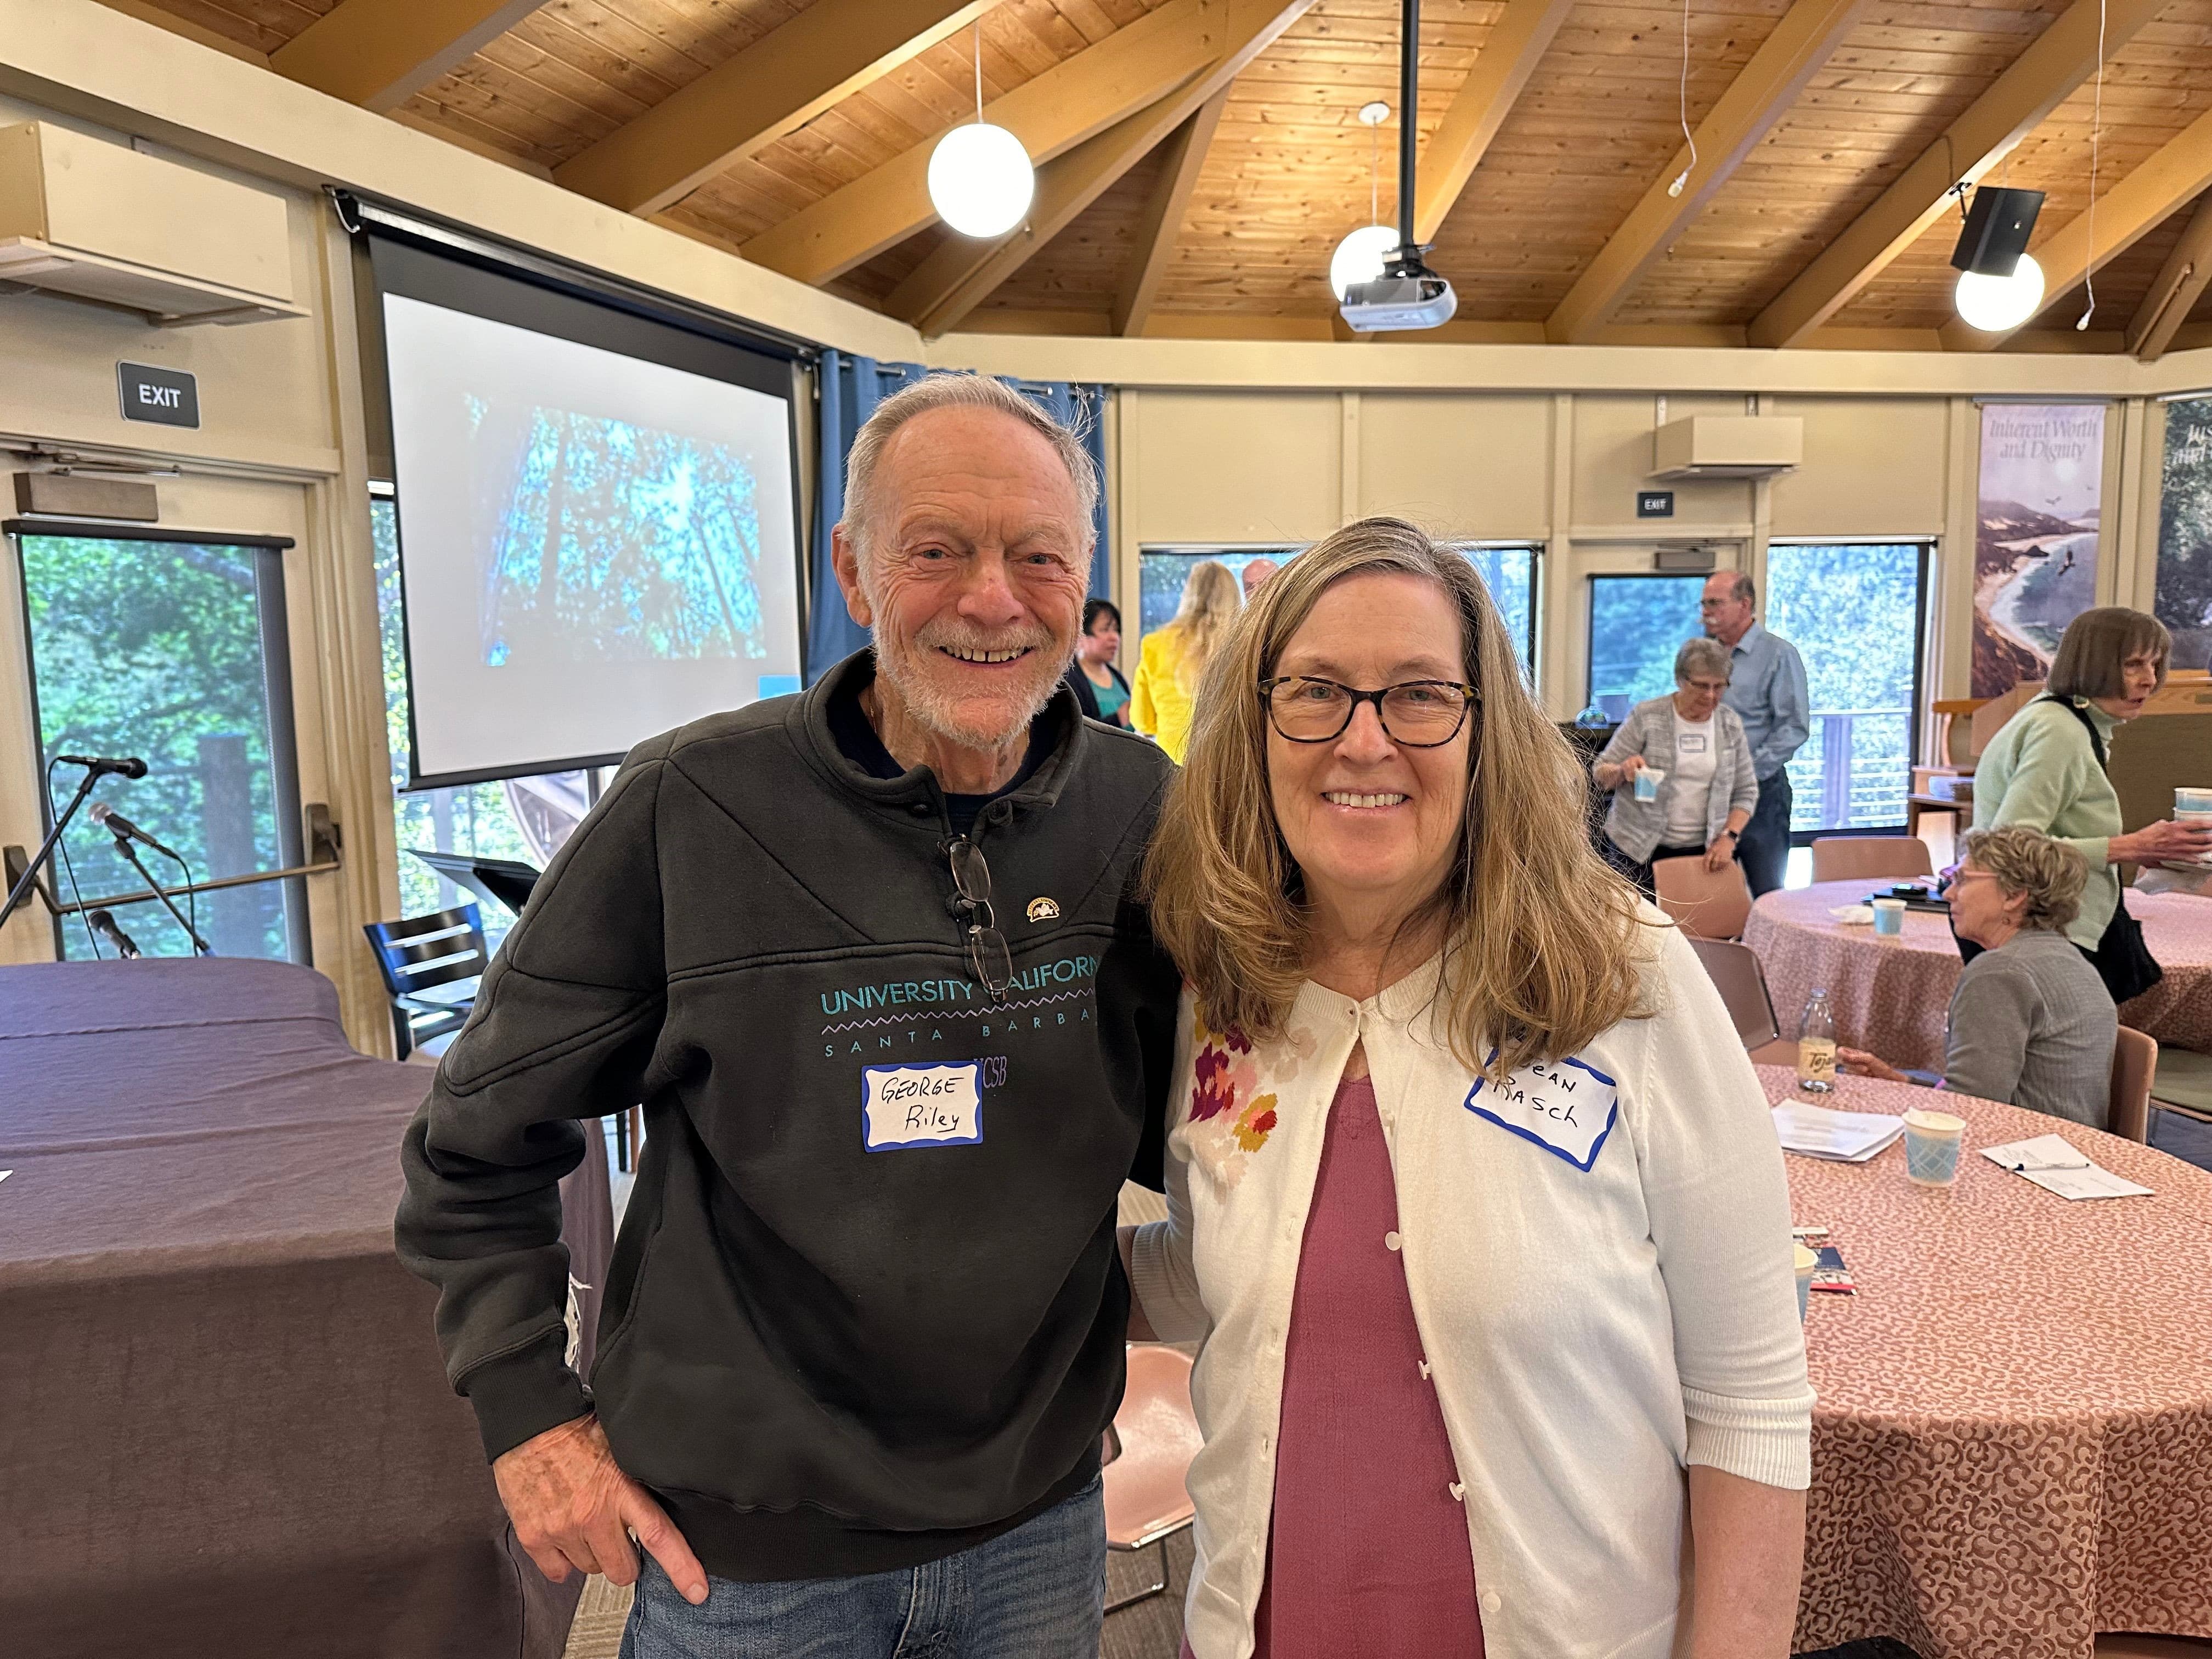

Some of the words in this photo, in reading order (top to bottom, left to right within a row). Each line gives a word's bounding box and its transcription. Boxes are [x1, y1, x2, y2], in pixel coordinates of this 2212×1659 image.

[138, 383, 182, 409] EXIT
[1990, 419, 2049, 438] Inherent
[2052, 418, 2098, 439] Worth
[2000, 439, 2027, 459] and
[2030, 439, 2086, 462] Dignity
[1644, 498, 1667, 510] EXIT
[821, 980, 973, 1015] UNIVERSITY
[825, 1029, 943, 1057] SANTA
[982, 1008, 1089, 1037] BARBA
[974, 1056, 1007, 1088] CSB
[882, 1076, 964, 1104] GEORGE
[905, 1104, 960, 1133] Riley
